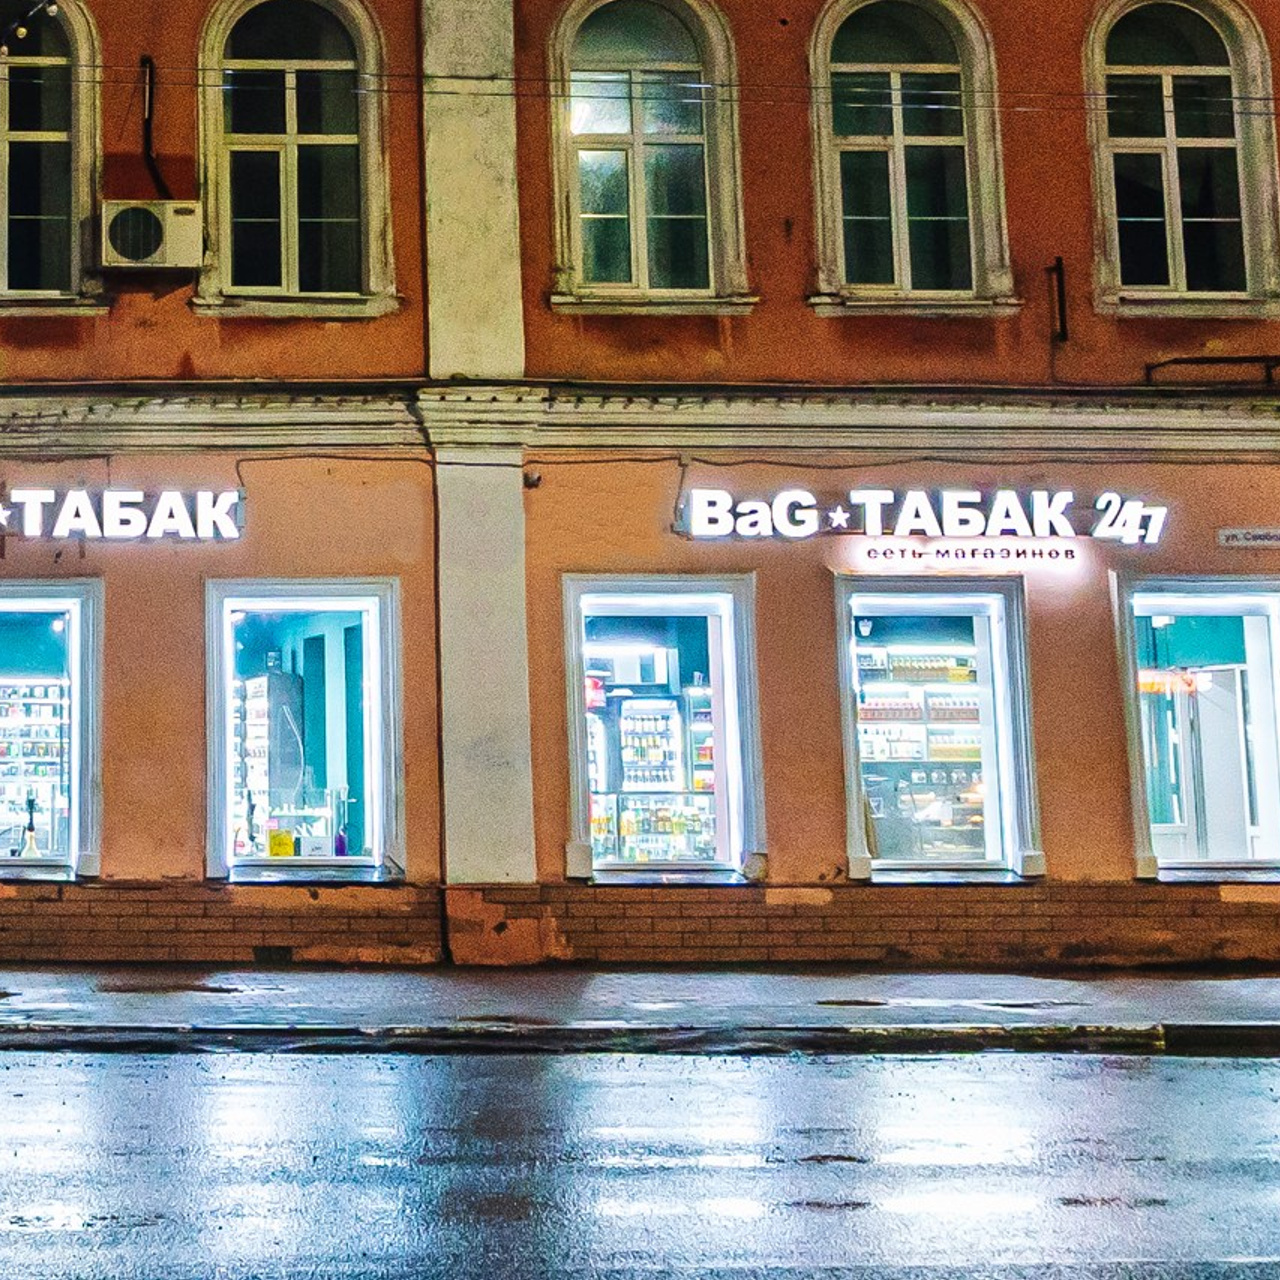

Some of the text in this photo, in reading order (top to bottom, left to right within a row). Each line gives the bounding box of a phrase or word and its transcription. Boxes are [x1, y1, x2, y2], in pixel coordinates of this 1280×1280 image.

[10, 489, 240, 539] ТАБАК
[690, 488, 819, 537] BaG
[851, 489, 1073, 538] ТАБАК
[935, 548, 1076, 560] магазинов
